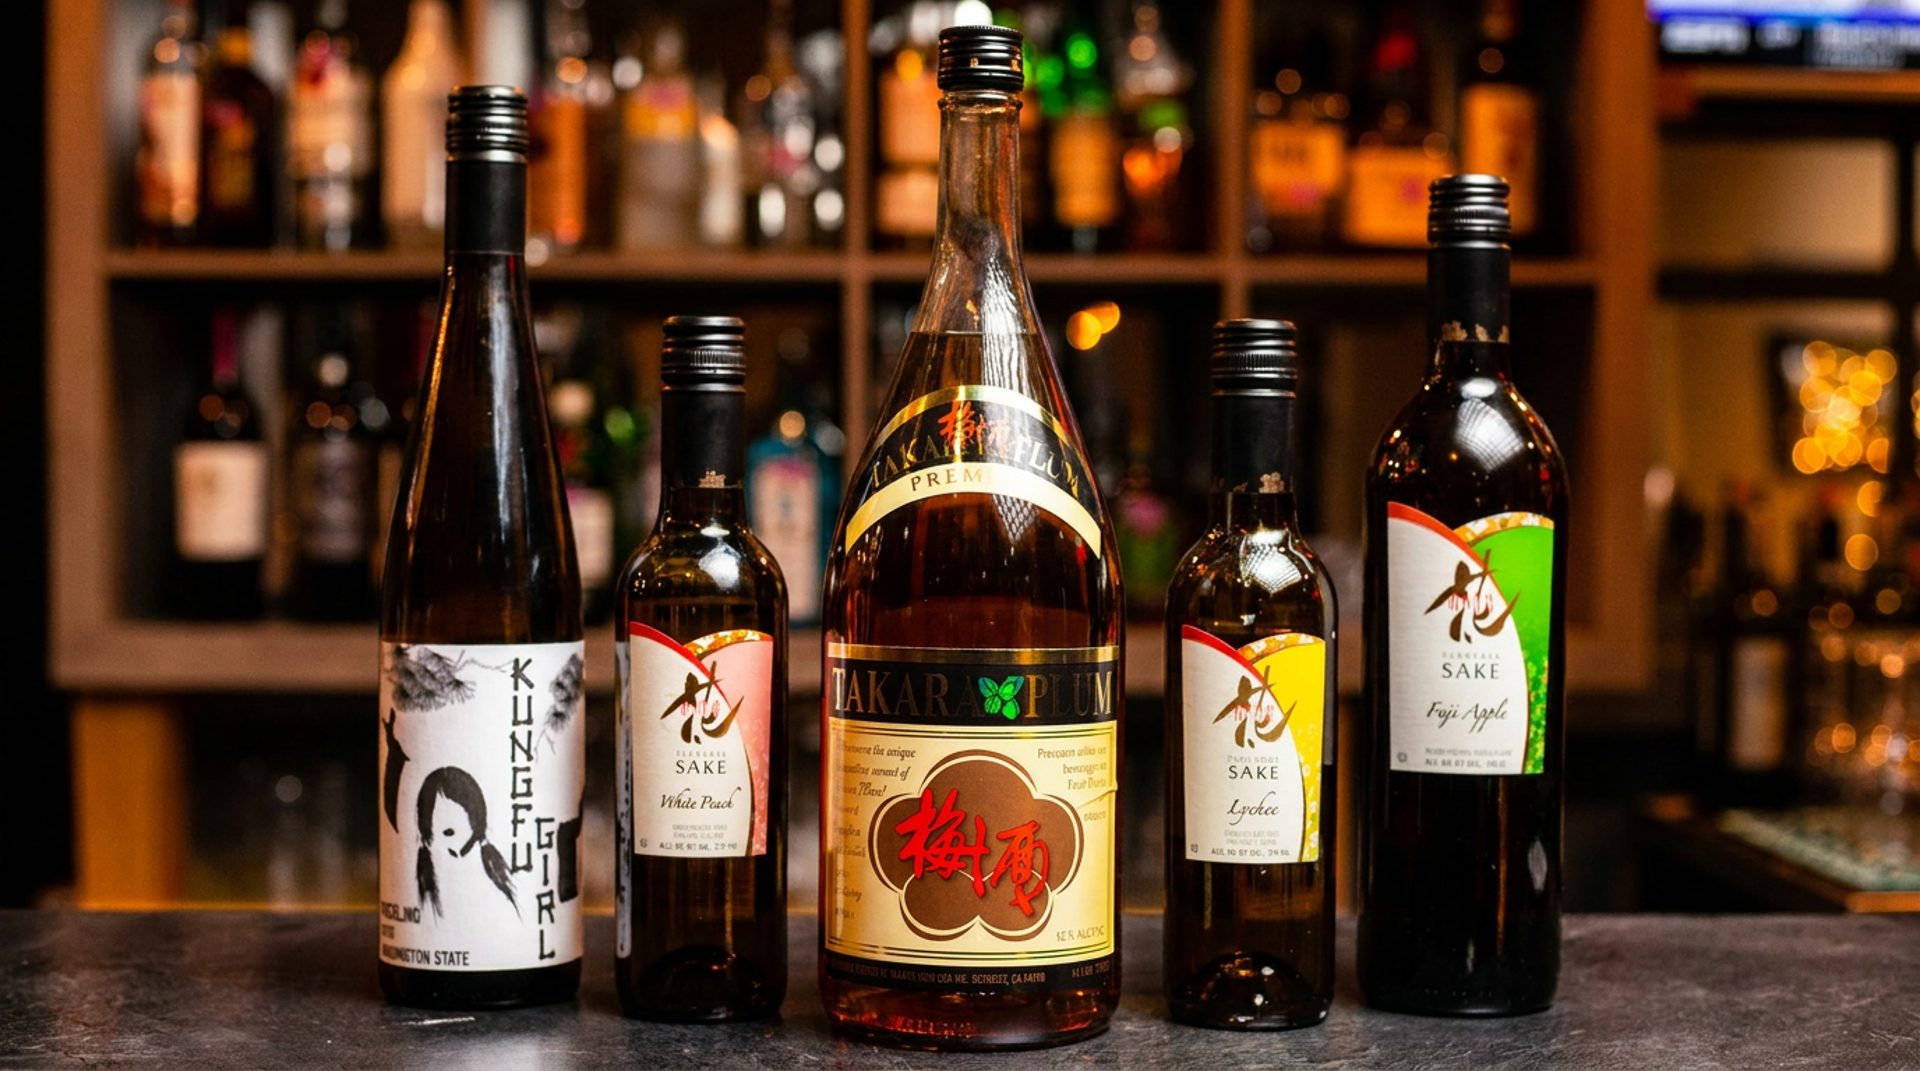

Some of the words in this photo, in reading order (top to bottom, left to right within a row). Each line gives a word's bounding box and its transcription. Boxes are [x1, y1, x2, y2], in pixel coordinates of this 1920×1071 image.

[911, 467, 990, 492] PREM
[1441, 662, 1500, 679] SAKE
[832, 667, 986, 718] TAKARA
[1025, 671, 1113, 718] PLUM
[1461, 698, 1509, 734] Apple
[676, 759, 727, 775] SAKE
[1228, 765, 1279, 780] SAKE
[1227, 791, 1280, 826] Lychee
[534, 817, 556, 961] GIRL
[434, 950, 470, 967] STATE
